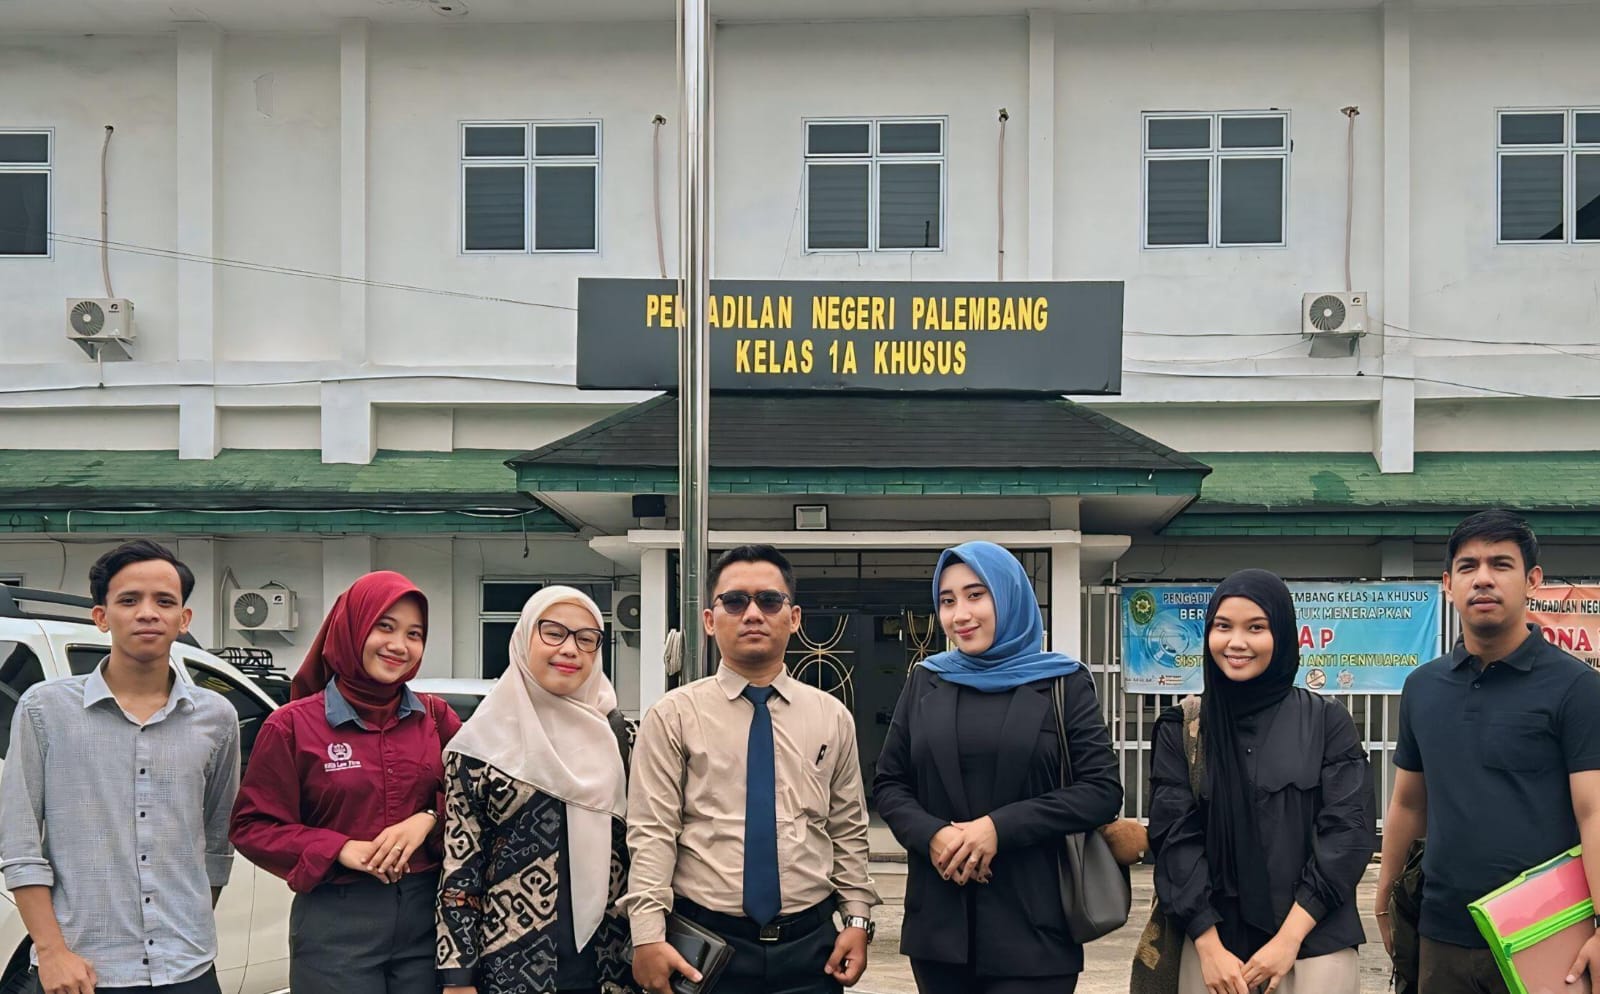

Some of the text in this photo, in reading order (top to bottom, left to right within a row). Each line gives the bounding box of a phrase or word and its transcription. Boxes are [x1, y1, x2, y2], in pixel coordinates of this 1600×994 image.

[645, 294, 1049, 332] PENADILAN NEGERI PALEMBANG
[736, 339, 967, 375] KELAS 1A KHUSUS
[1163, 592, 1210, 604] PENGADI
[1338, 591, 1368, 602] KELAS
[1372, 592, 1384, 602] 1A
[1388, 591, 1429, 602] KHUSUS
[1295, 606, 1412, 620] TUK MENERAPKAN
[1581, 600, 1600, 613] NEG
[1299, 625, 1335, 649] AP
[1174, 654, 1204, 667] SIST
[1307, 654, 1338, 667] ANTI
[1340, 654, 1419, 667] PENYUAPAN
